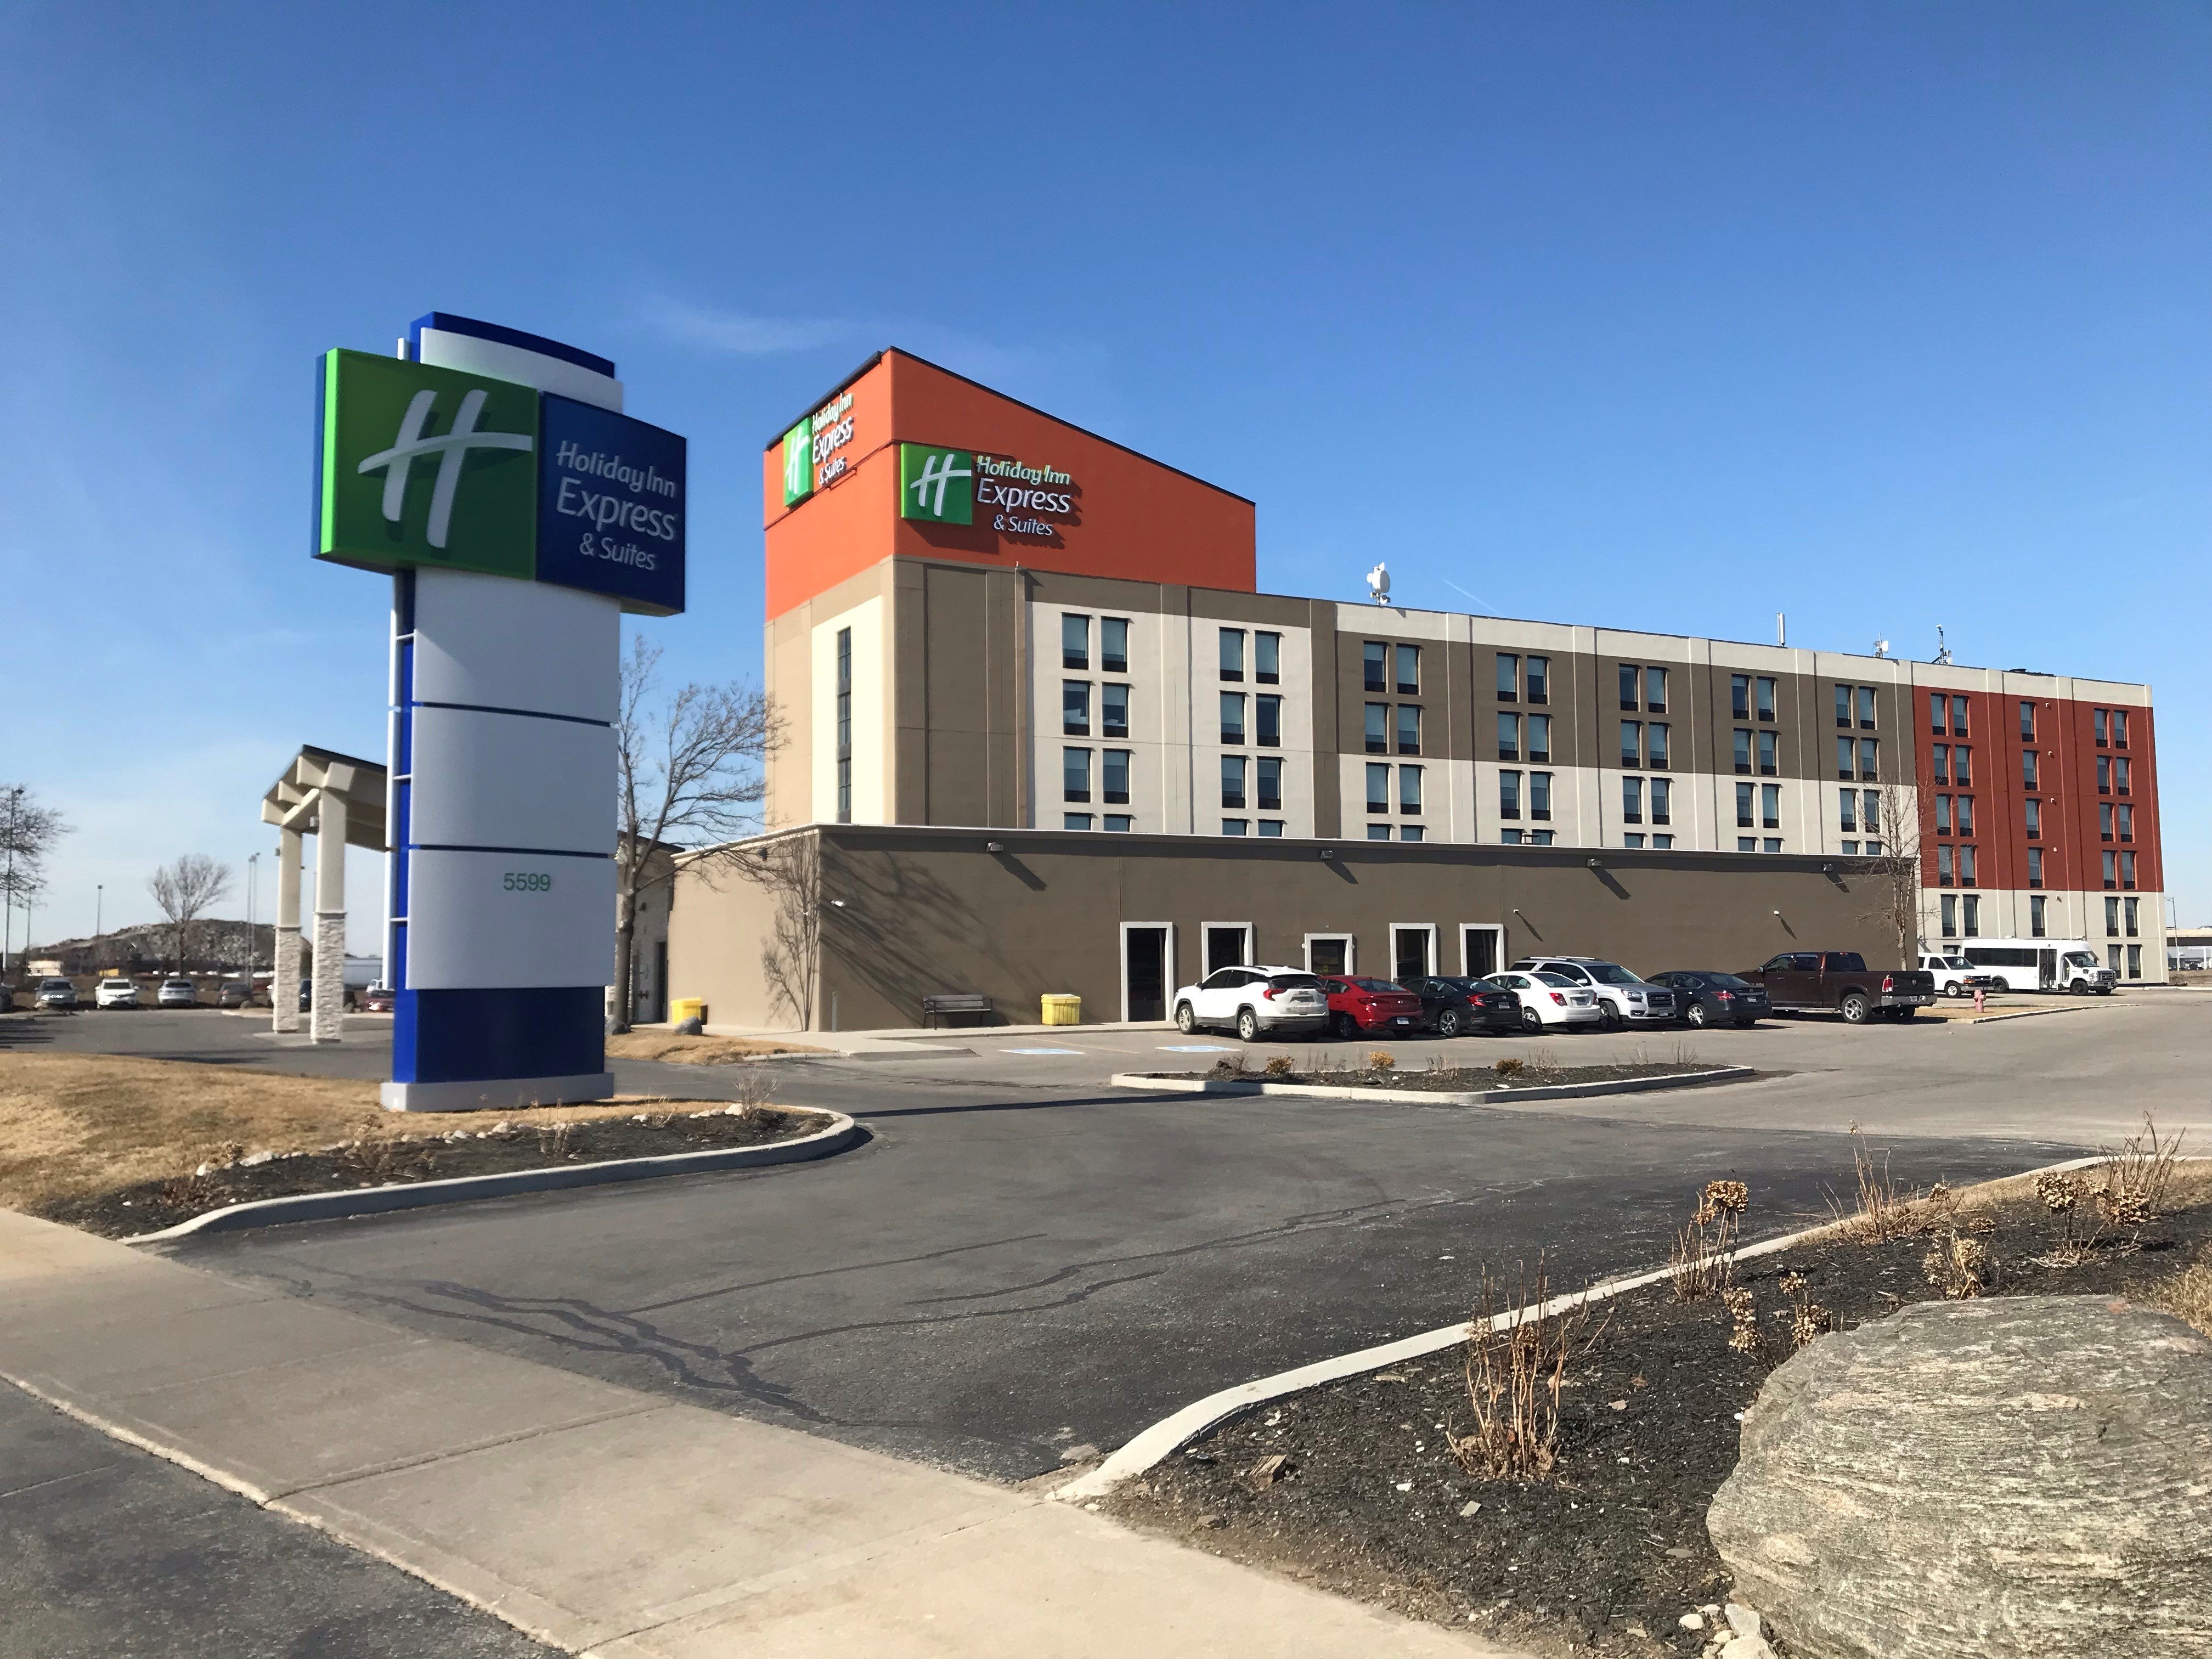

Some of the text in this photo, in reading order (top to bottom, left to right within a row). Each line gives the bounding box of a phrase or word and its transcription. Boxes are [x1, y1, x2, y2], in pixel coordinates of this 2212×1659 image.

[812, 393, 853, 434] Holiday Inn
[812, 416, 853, 464] Express
[556, 441, 675, 498] Holiday Inn
[819, 456, 845, 485] & Suites
[977, 455, 1070, 486] Holiday Inn
[557, 476, 675, 540] Express
[977, 477, 1070, 512] Express
[994, 514, 1053, 535] & Suites
[579, 533, 656, 571] & Suites
[504, 873, 550, 891] 5599
